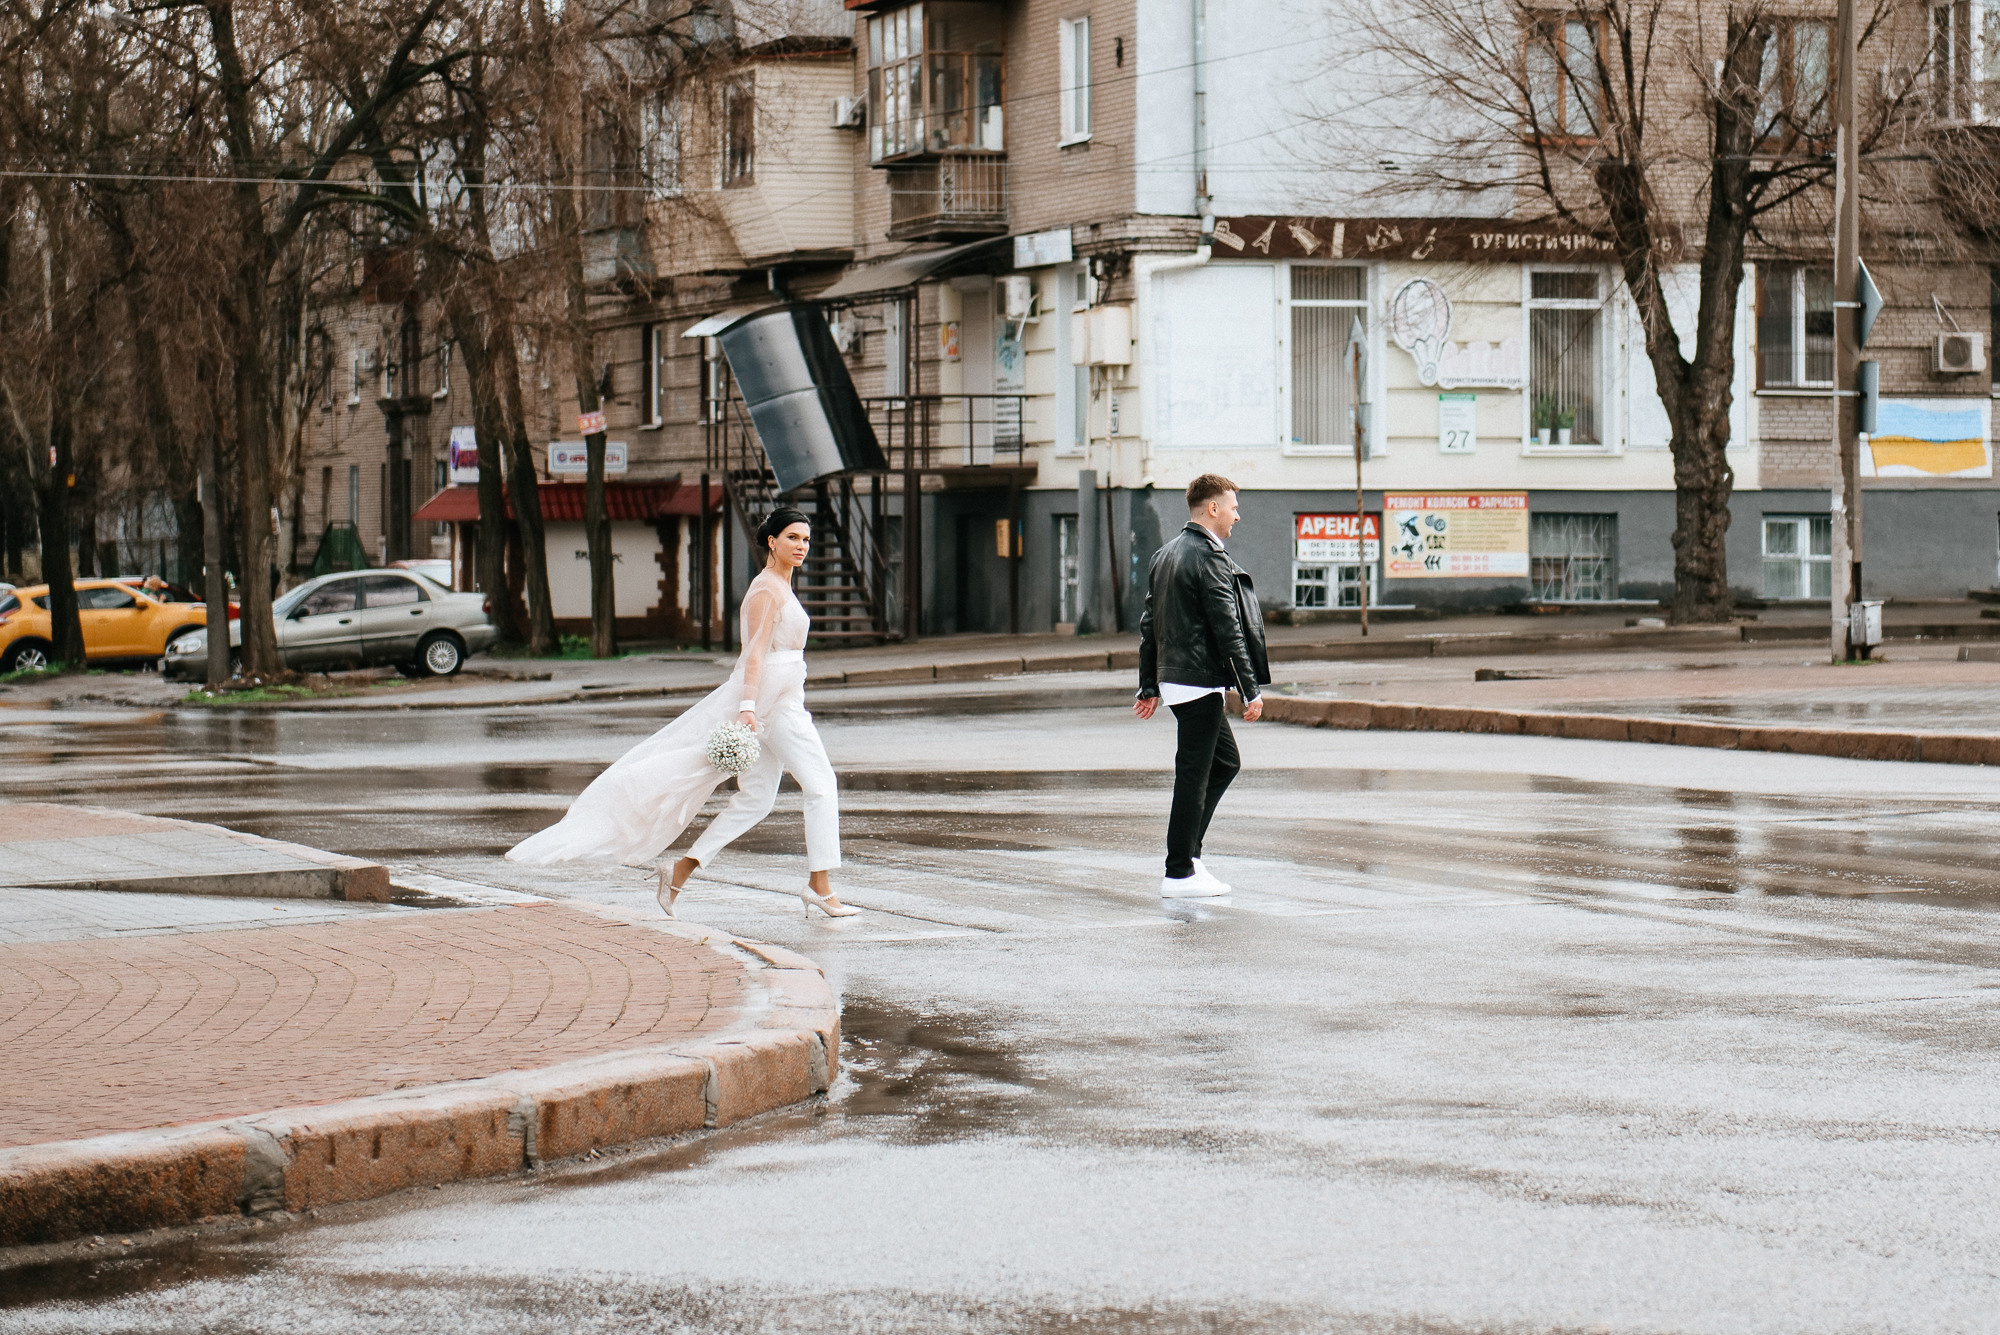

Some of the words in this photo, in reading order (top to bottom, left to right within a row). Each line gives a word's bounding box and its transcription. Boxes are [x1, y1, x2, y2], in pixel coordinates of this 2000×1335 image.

[1447, 429, 1470, 449] 27
[1387, 496, 1425, 509] РЕМОНТ
[1300, 516, 1376, 538] АРЕНДА
